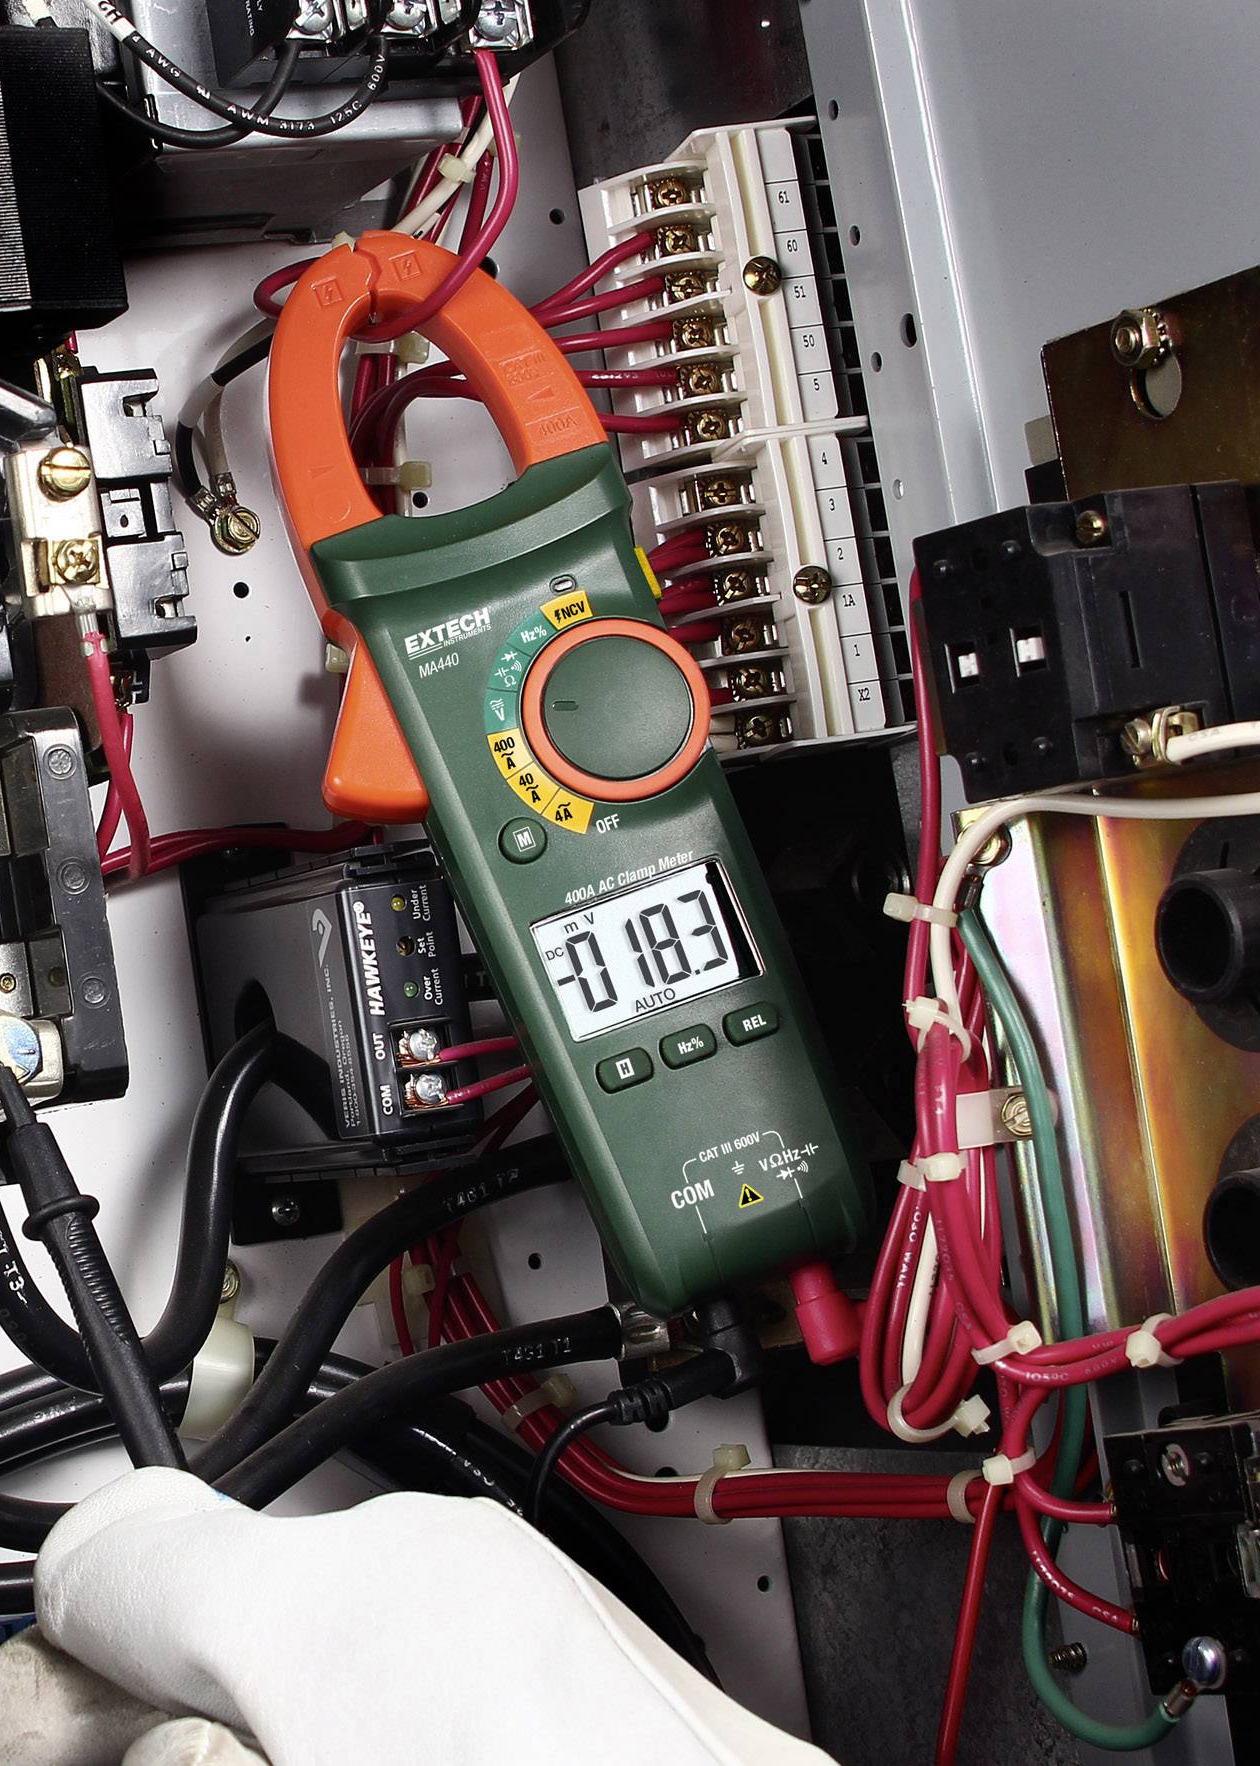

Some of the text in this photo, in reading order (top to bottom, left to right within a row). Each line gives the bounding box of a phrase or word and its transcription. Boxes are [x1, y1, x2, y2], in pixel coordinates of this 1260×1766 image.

[146, 48, 180, 78] AWG
[227, 104, 270, 126] AWM
[330, 100, 362, 125] 125C
[367, 54, 386, 91] 600V
[779, 190, 790, 204] 61
[786, 238, 798, 253] 60
[793, 285, 806, 299] 51
[802, 333, 815, 348] 50
[813, 377, 820, 392] 5
[820, 451, 828, 465] 4
[829, 497, 836, 511] 3
[837, 547, 844, 561] 2
[561, 600, 586, 621] NCV
[843, 593, 856, 608] 1A
[404, 607, 491, 654] EXTECH
[520, 625, 547, 644] Hz%
[853, 643, 860, 657] 1
[418, 652, 460, 679] MA440
[858, 686, 871, 702] X2
[493, 737, 515, 753] 400
[519, 773, 534, 786] 40
[555, 807, 573, 822] 4A
[595, 813, 620, 834] OFF
[516, 830, 534, 849] M
[565, 850, 694, 905] 400A AC Clamp Meter
[411, 888, 422, 920] Under
[418, 884, 431, 922] Current
[417, 936, 427, 955] Set
[427, 931, 437, 958] Point
[545, 946, 566, 961] DC
[323, 964, 332, 993] INC.
[423, 975, 433, 1001] Over
[430, 967, 444, 1006] Current
[634, 987, 677, 1013] AUTO
[742, 1014, 768, 1033] REL
[337, 1019, 348, 1066] Oregon
[372, 1033, 386, 1060] OUT
[677, 1036, 705, 1056] Hz%
[620, 1062, 631, 1077] H
[340, 1087, 352, 1129] VERIS
[380, 1084, 394, 1115] COM
[698, 1131, 760, 1163] CAT III 600V
[670, 1178, 715, 1210] COM
[896, 1250, 914, 1288] WALL
